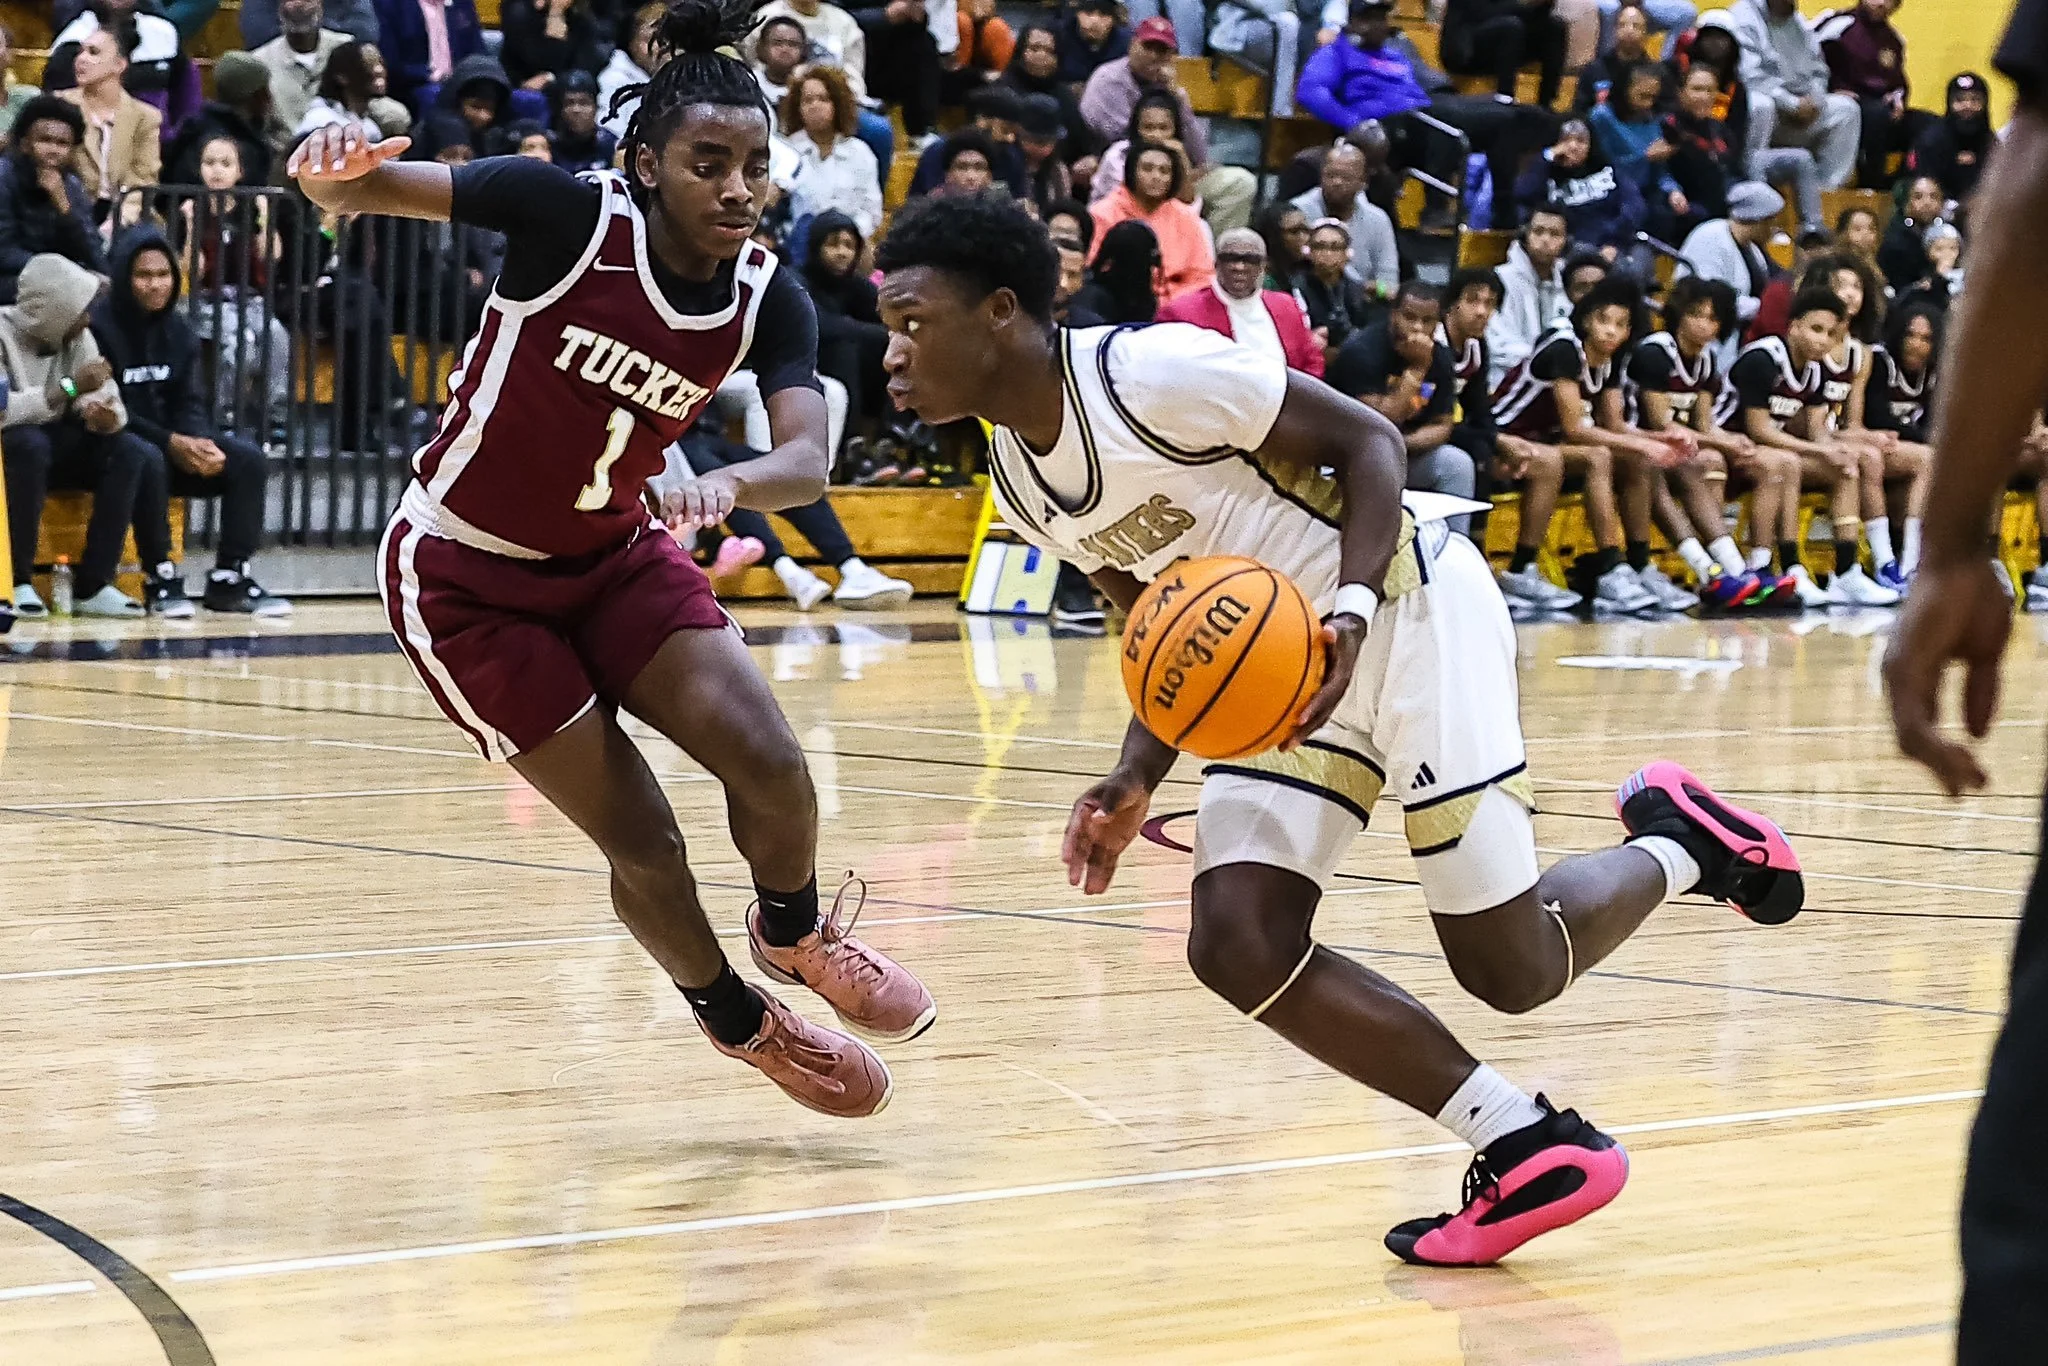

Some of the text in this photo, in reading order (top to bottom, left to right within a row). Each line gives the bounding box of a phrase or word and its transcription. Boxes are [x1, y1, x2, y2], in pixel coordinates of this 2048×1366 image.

[553, 324, 711, 421] TUCKER
[574, 406, 636, 512] 1
[1153, 594, 1251, 710] Wilson
